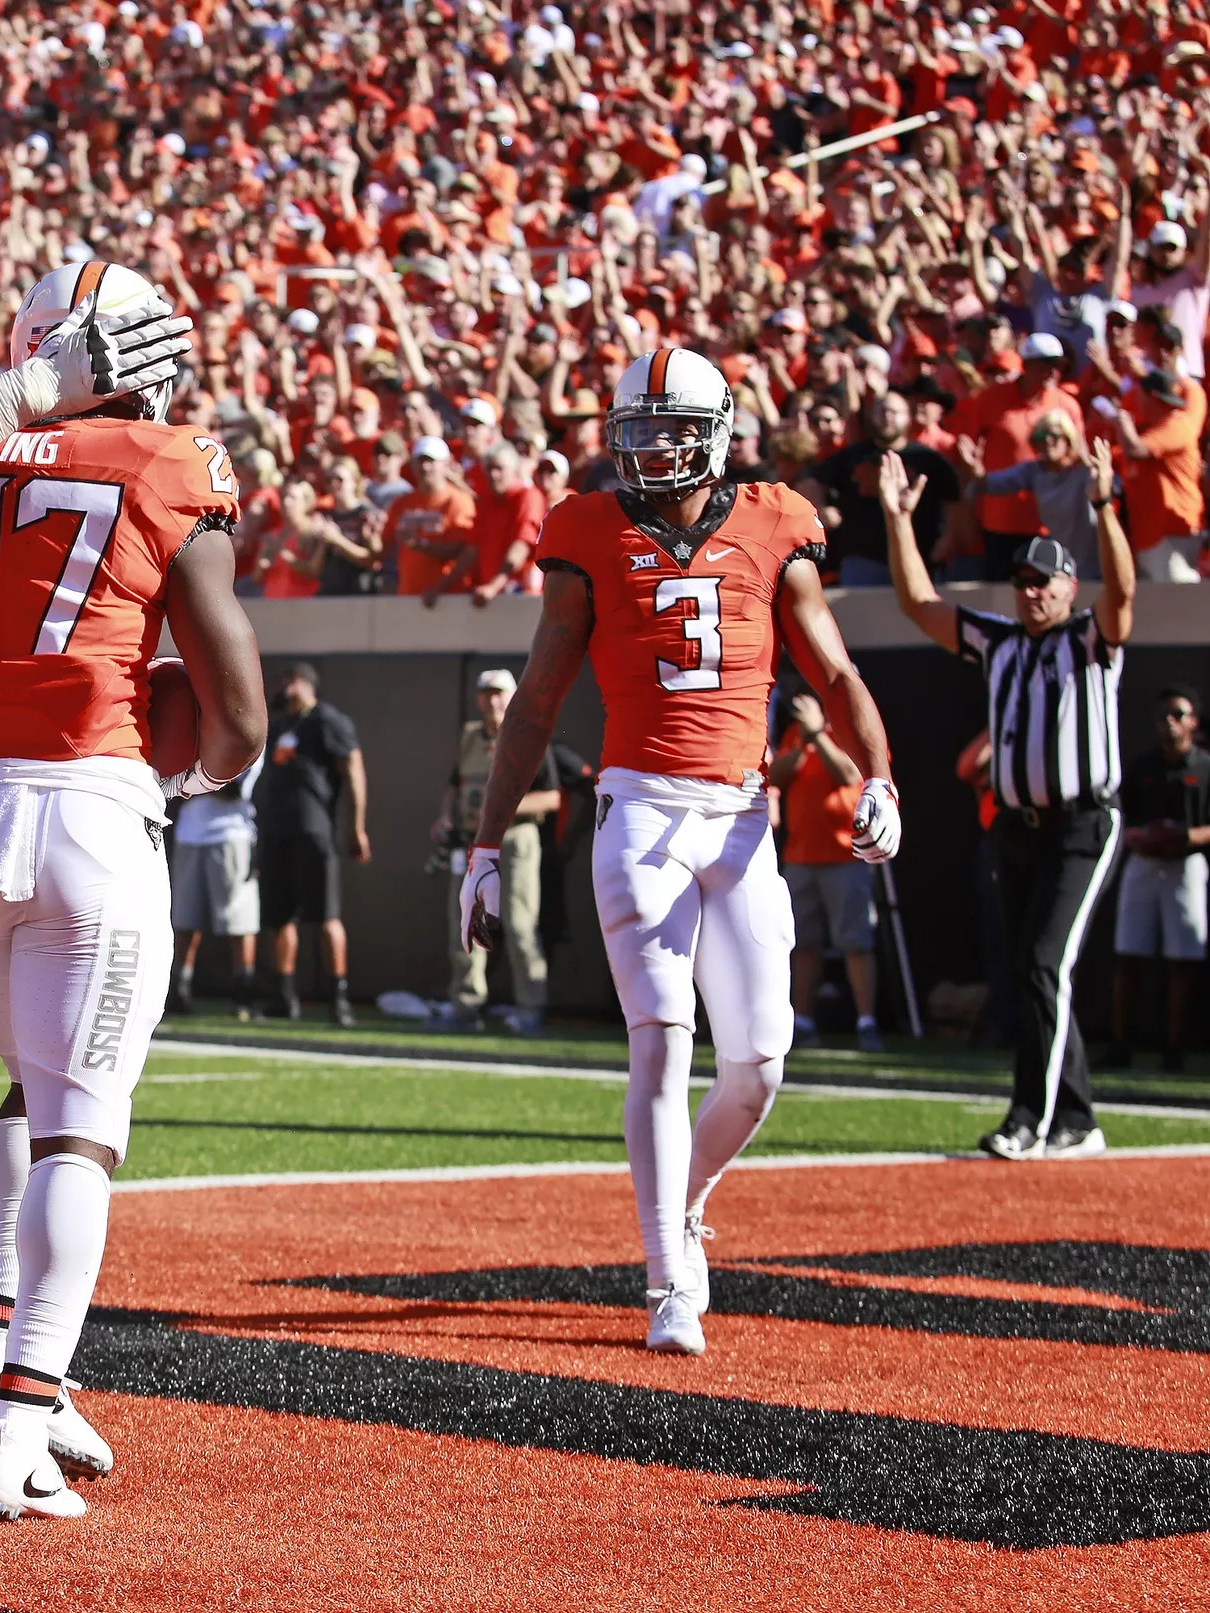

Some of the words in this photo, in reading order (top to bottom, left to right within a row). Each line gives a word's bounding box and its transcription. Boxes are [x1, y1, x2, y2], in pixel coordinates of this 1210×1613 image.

[193, 435, 241, 501] 2
[629, 552, 660, 571] XII
[653, 575, 726, 693] 3
[81, 929, 141, 1072] COWBOYS
